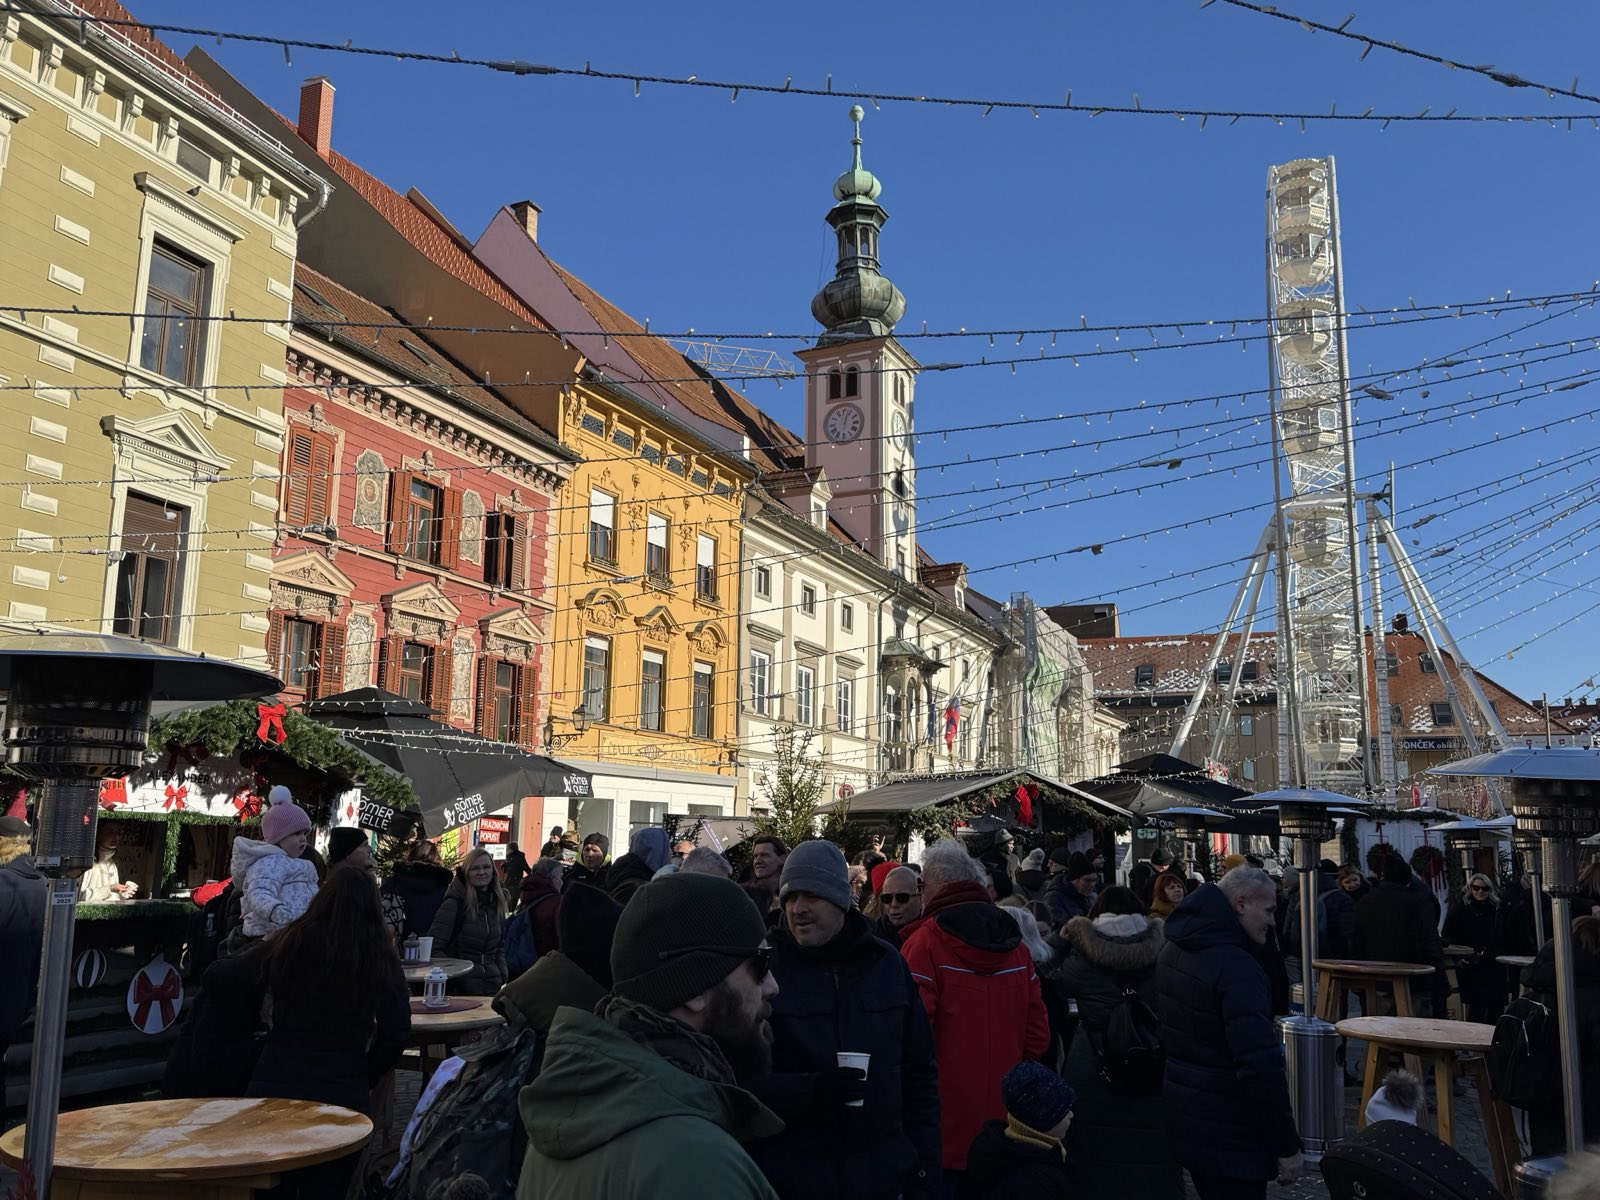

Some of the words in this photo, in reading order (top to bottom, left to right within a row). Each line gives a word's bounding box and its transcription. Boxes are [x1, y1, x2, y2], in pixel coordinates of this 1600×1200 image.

[147, 770, 211, 785] ALEXANDER
[458, 802, 487, 824] QUELLE
[480, 832, 500, 841] POPUST
